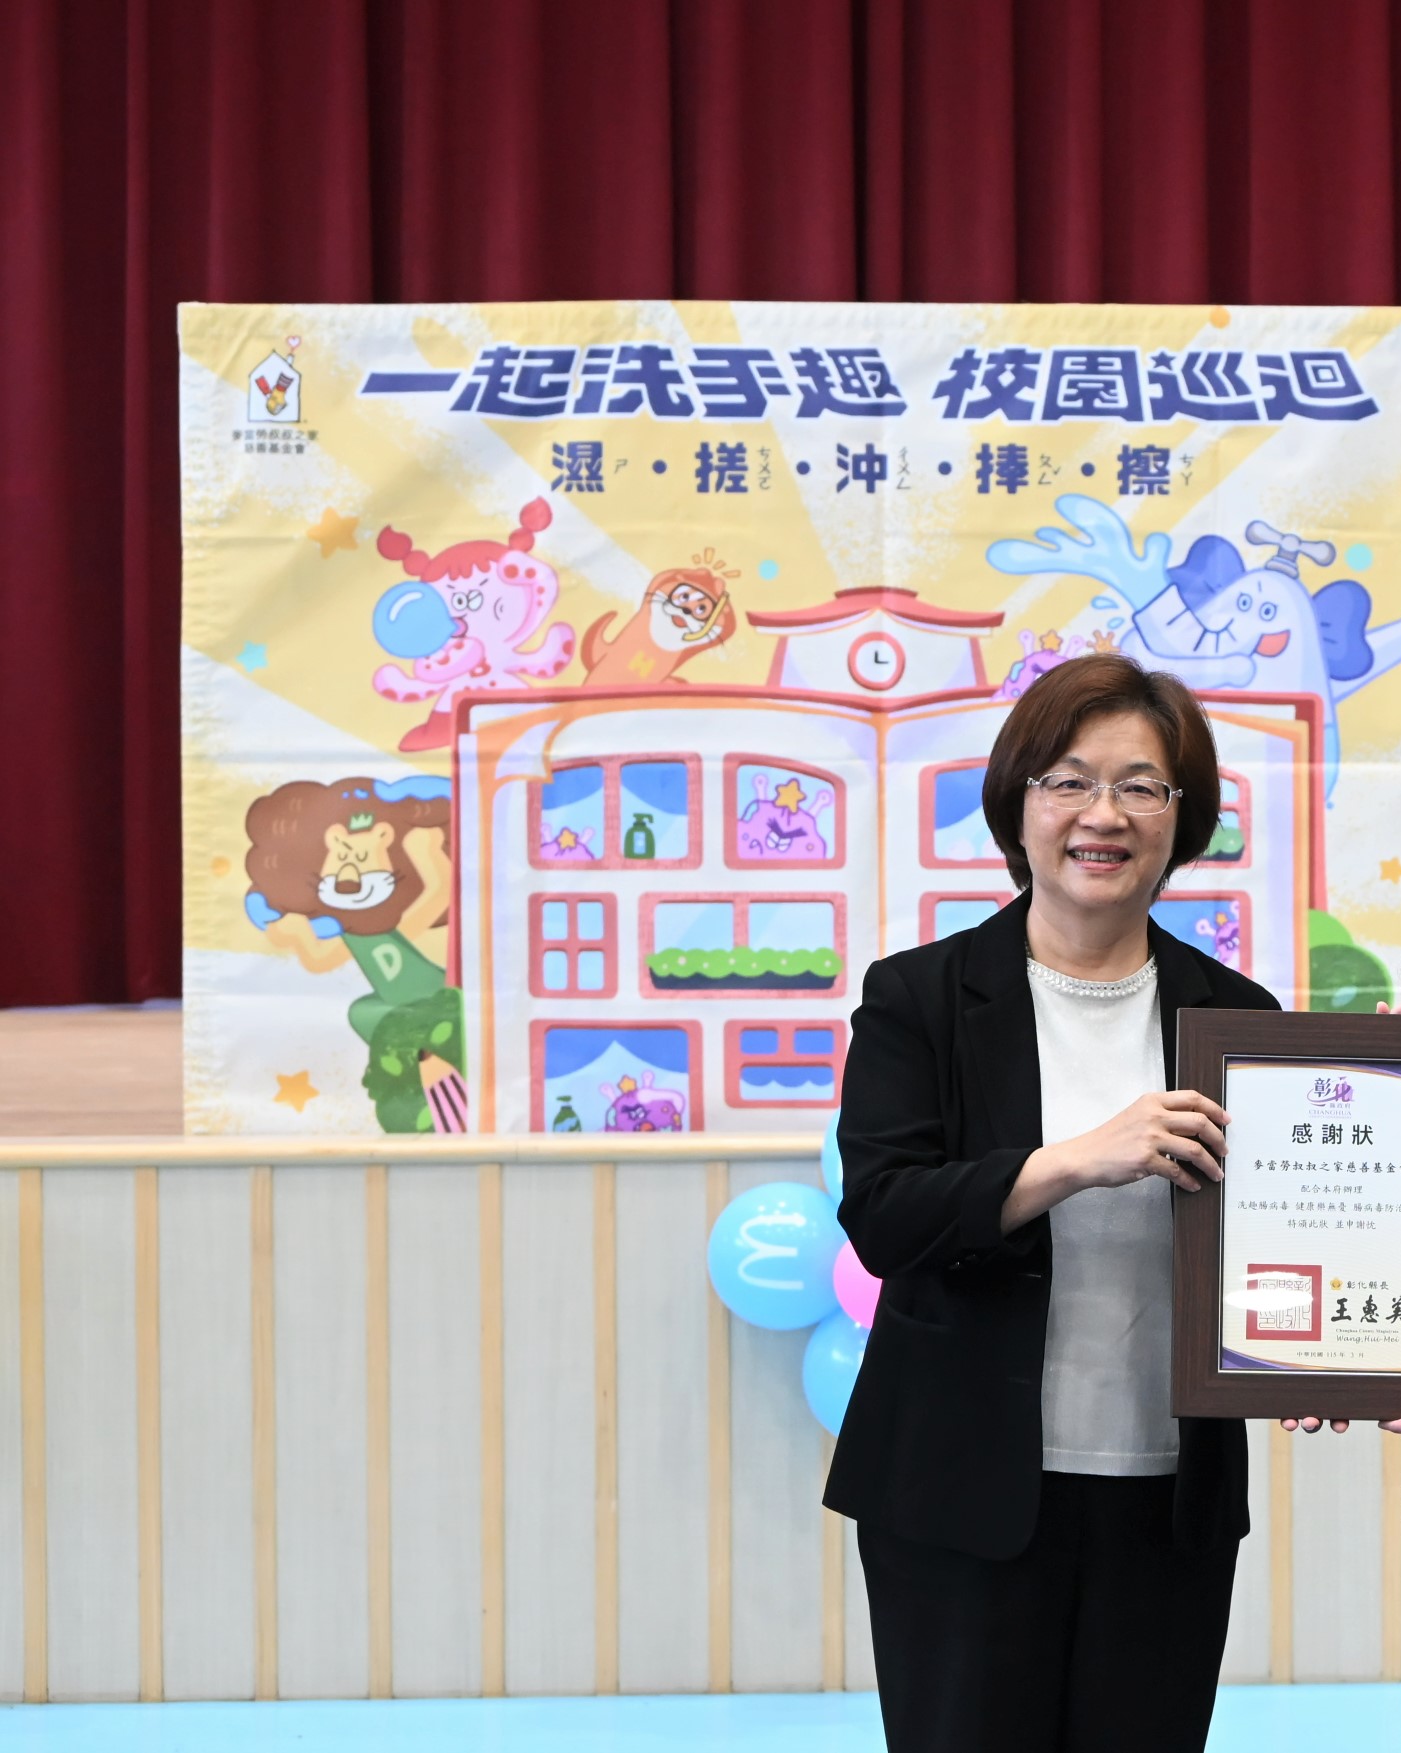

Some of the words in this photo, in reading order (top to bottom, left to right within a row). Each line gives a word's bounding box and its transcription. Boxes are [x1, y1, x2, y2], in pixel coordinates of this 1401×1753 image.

[361, 345, 908, 419] 一起洗手趣
[931, 347, 1382, 423] 校園巡迴
[371, 943, 403, 982] D
[1291, 1122, 1374, 1146] 感謝狀
[1346, 1280, 1390, 1291] 彰化縣長
